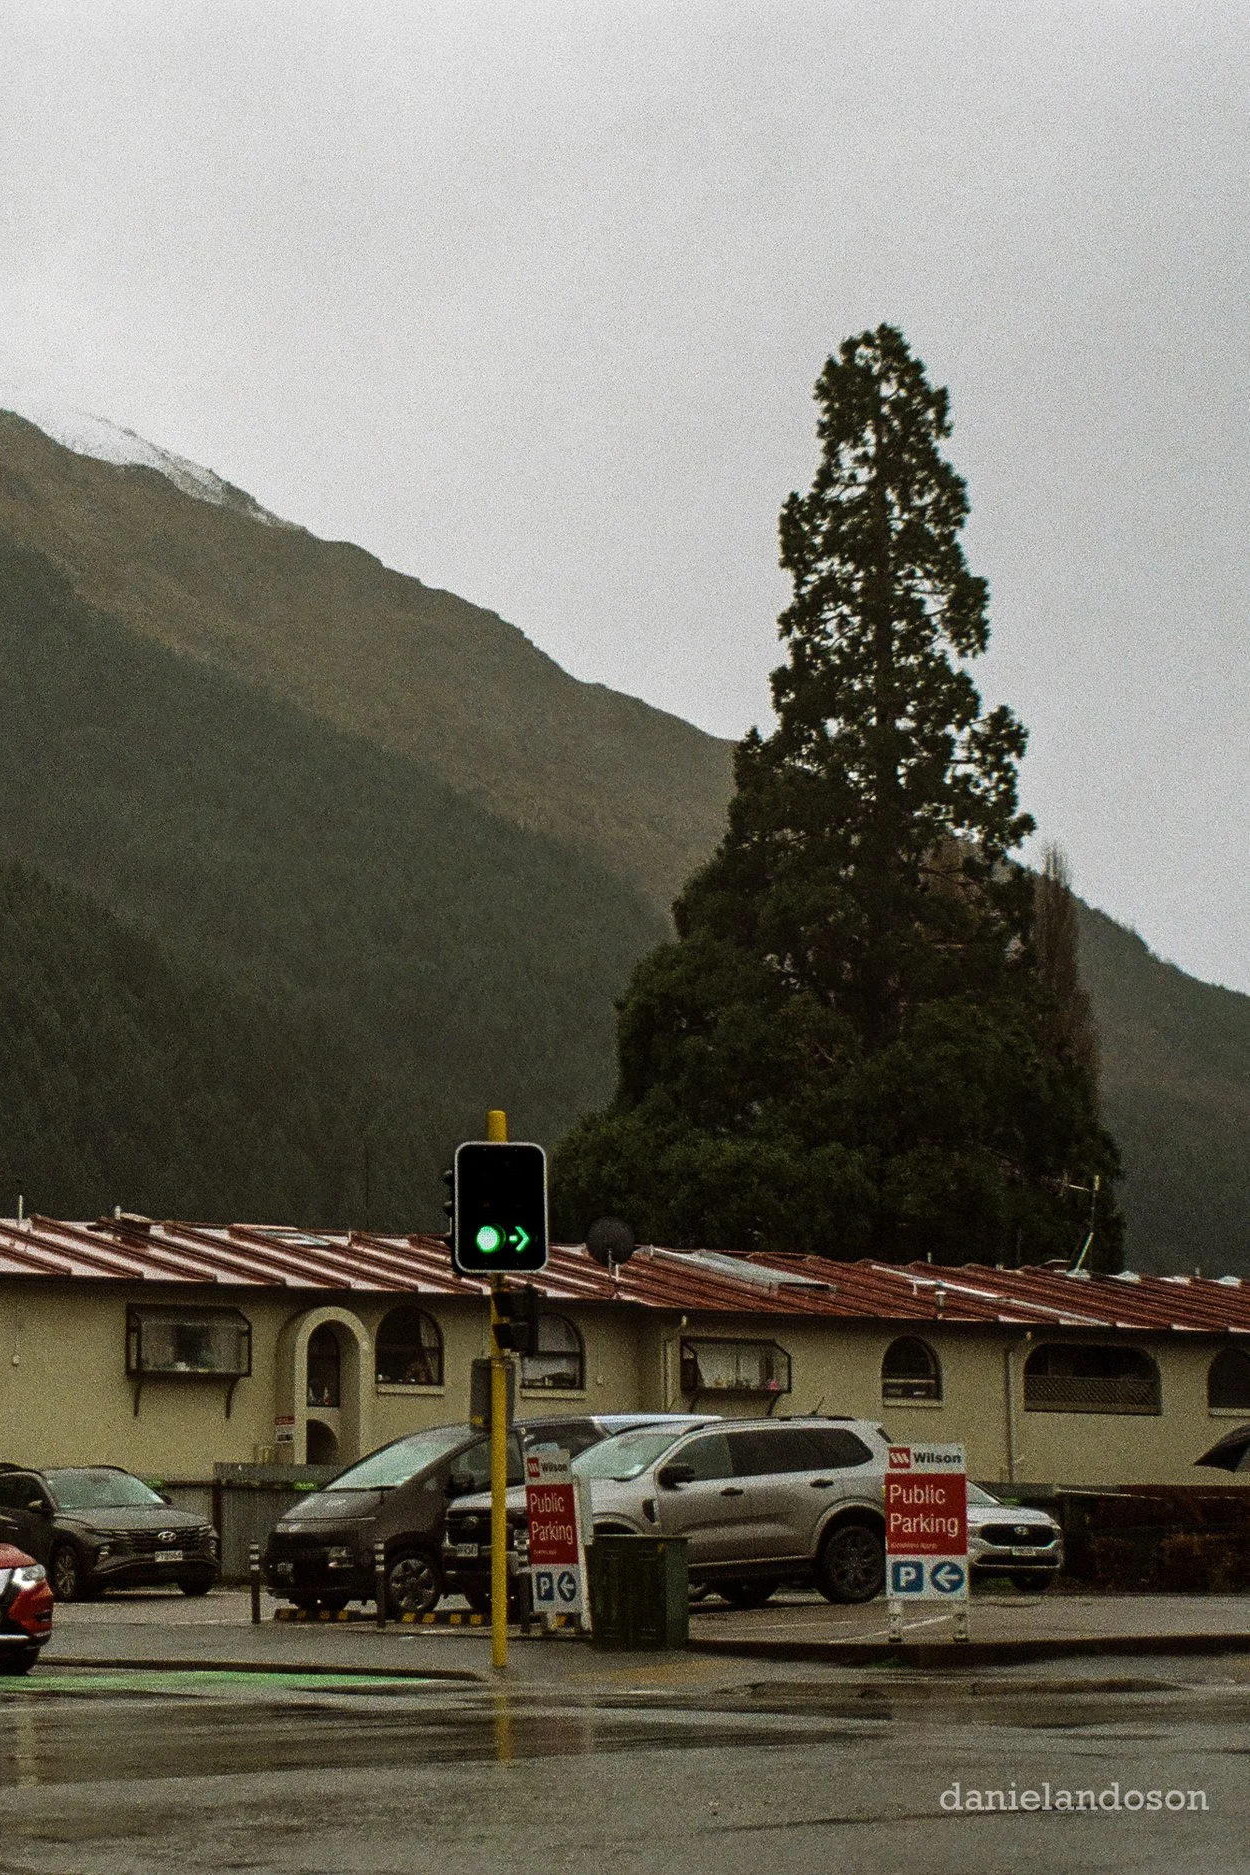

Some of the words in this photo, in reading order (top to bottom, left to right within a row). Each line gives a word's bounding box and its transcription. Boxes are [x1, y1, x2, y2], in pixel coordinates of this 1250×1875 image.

[542, 1462, 568, 1473] Wilson
[914, 1452, 962, 1464] Wilson
[530, 1492, 565, 1513] Public
[889, 1484, 946, 1504] Public
[532, 1520, 574, 1545] Parking
[890, 1513, 959, 1537] Parking
[900, 1566, 917, 1587] P
[539, 1577, 551, 1598] P
